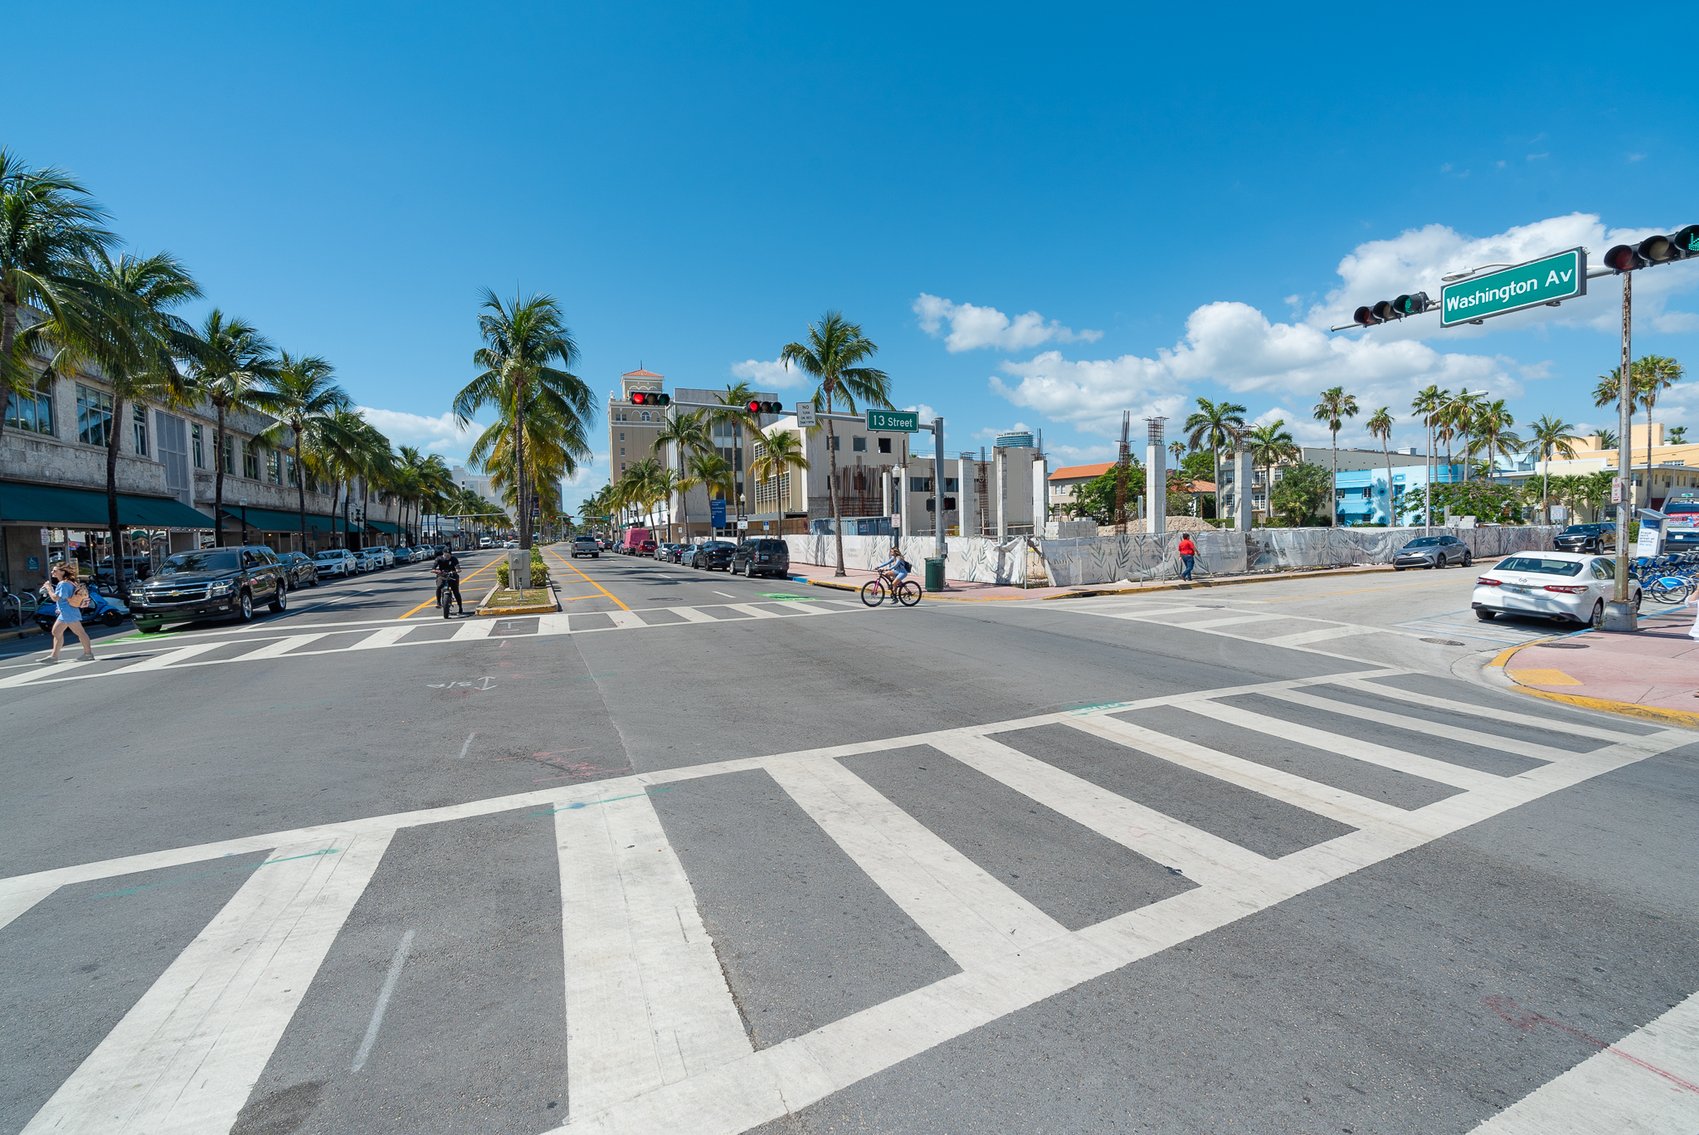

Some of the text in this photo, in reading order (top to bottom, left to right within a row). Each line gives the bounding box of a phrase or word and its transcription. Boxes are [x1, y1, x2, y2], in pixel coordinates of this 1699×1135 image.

[1446, 269, 1573, 312] Washington Av
[873, 415, 913, 427] 13 Street
